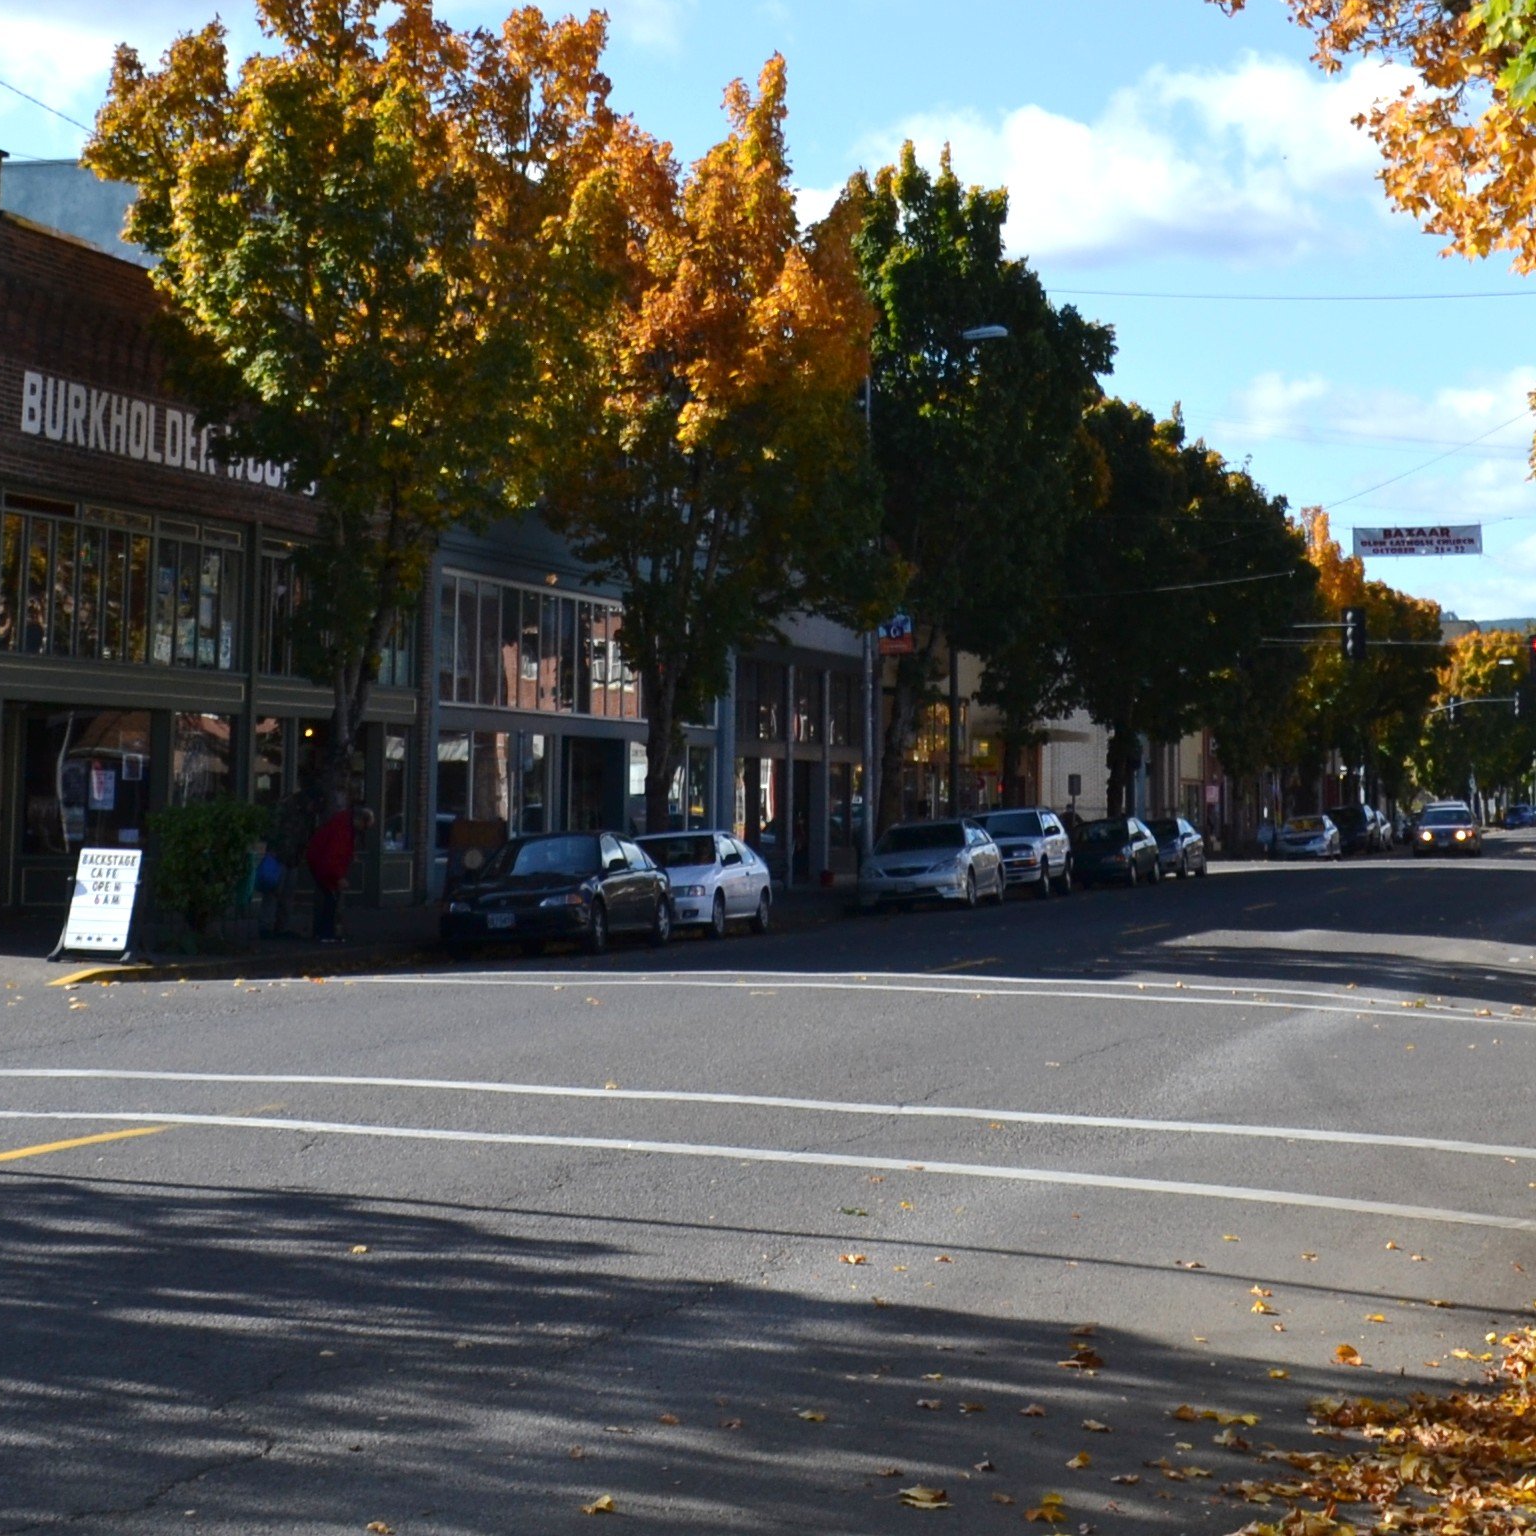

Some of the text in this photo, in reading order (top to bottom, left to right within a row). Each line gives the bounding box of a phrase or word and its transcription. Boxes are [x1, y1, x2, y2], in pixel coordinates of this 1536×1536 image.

[1372, 546, 1416, 554] OCTOBER
[81, 853, 138, 866] BACKSTAGE
[90, 867, 119, 879] CAFE
[91, 881, 122, 892] OPEN
